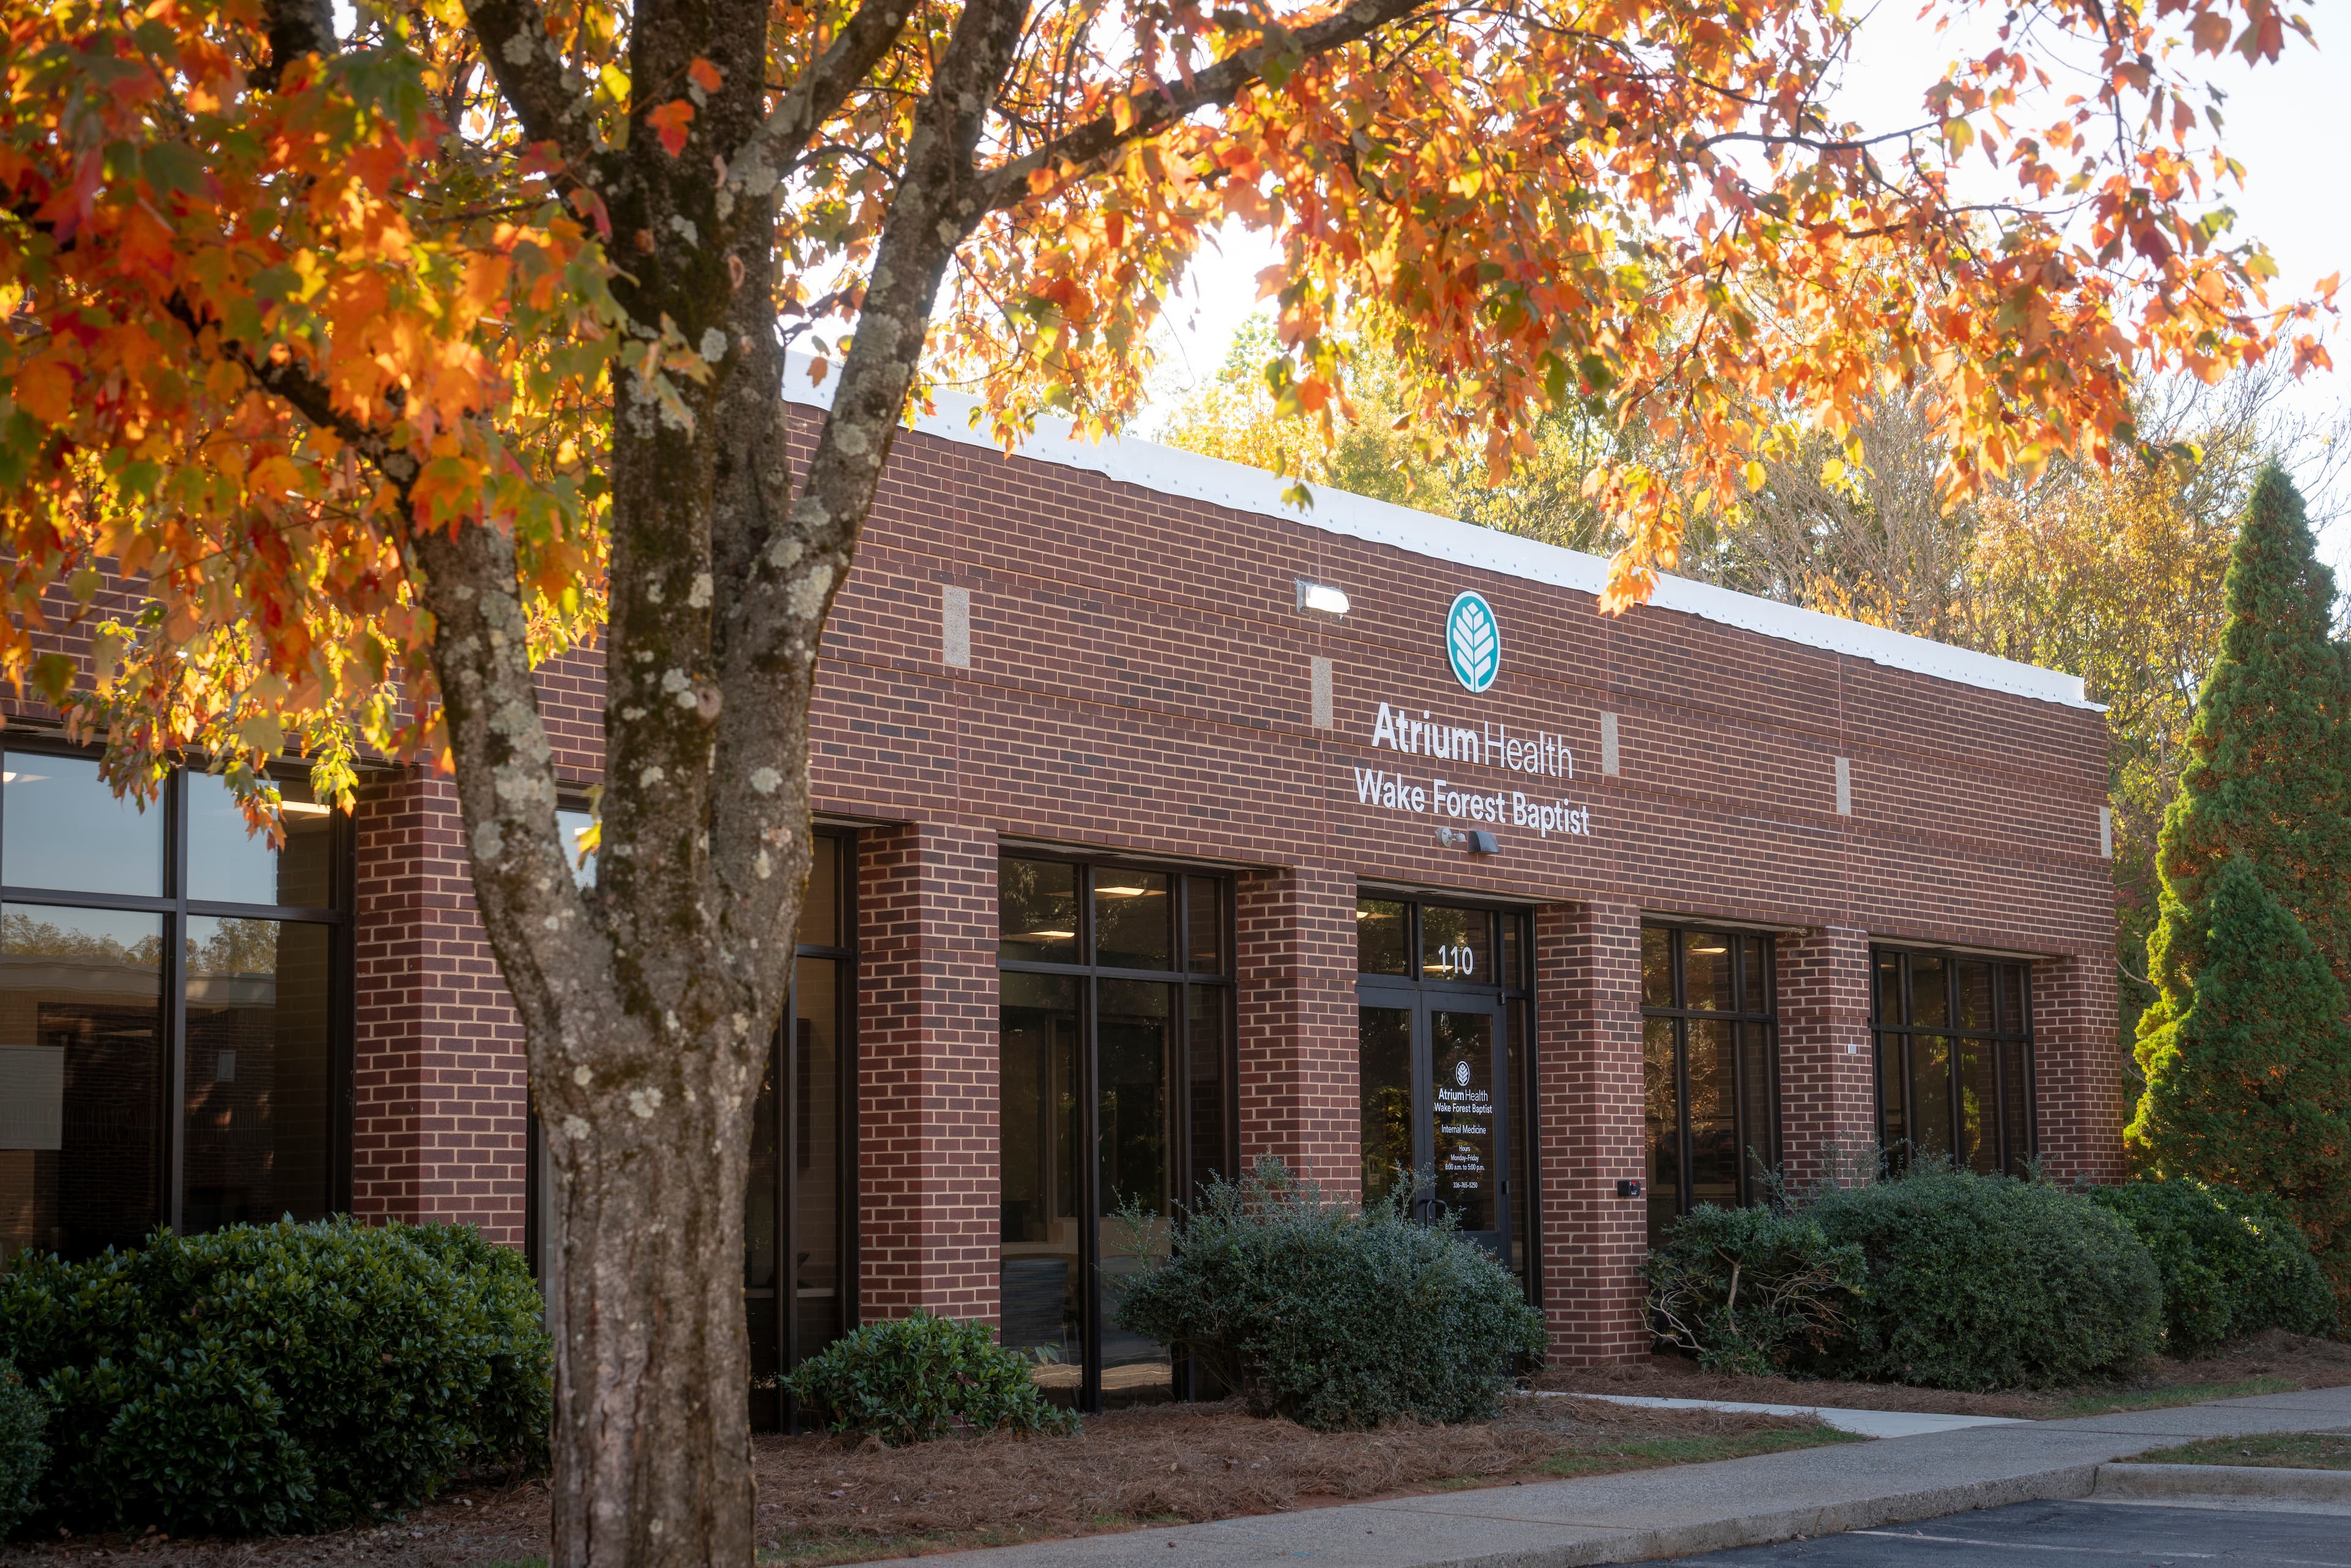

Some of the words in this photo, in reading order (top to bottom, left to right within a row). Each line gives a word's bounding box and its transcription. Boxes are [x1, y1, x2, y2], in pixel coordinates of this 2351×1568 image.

[1371, 702, 1479, 763] Atrium
[1484, 720, 1573, 779] Health
[1354, 767, 1425, 813] Wake
[1433, 778, 1506, 824] Forest
[1512, 791, 1590, 838] Baptist
[1438, 945, 1474, 975] 110
[1434, 1102, 1451, 1112] Wake
[1452, 1103, 1471, 1113] Forest
[1472, 1103, 1493, 1116] Baptist
[1441, 1123, 1461, 1134] Internal
[1462, 1124, 1487, 1134] Medicine
